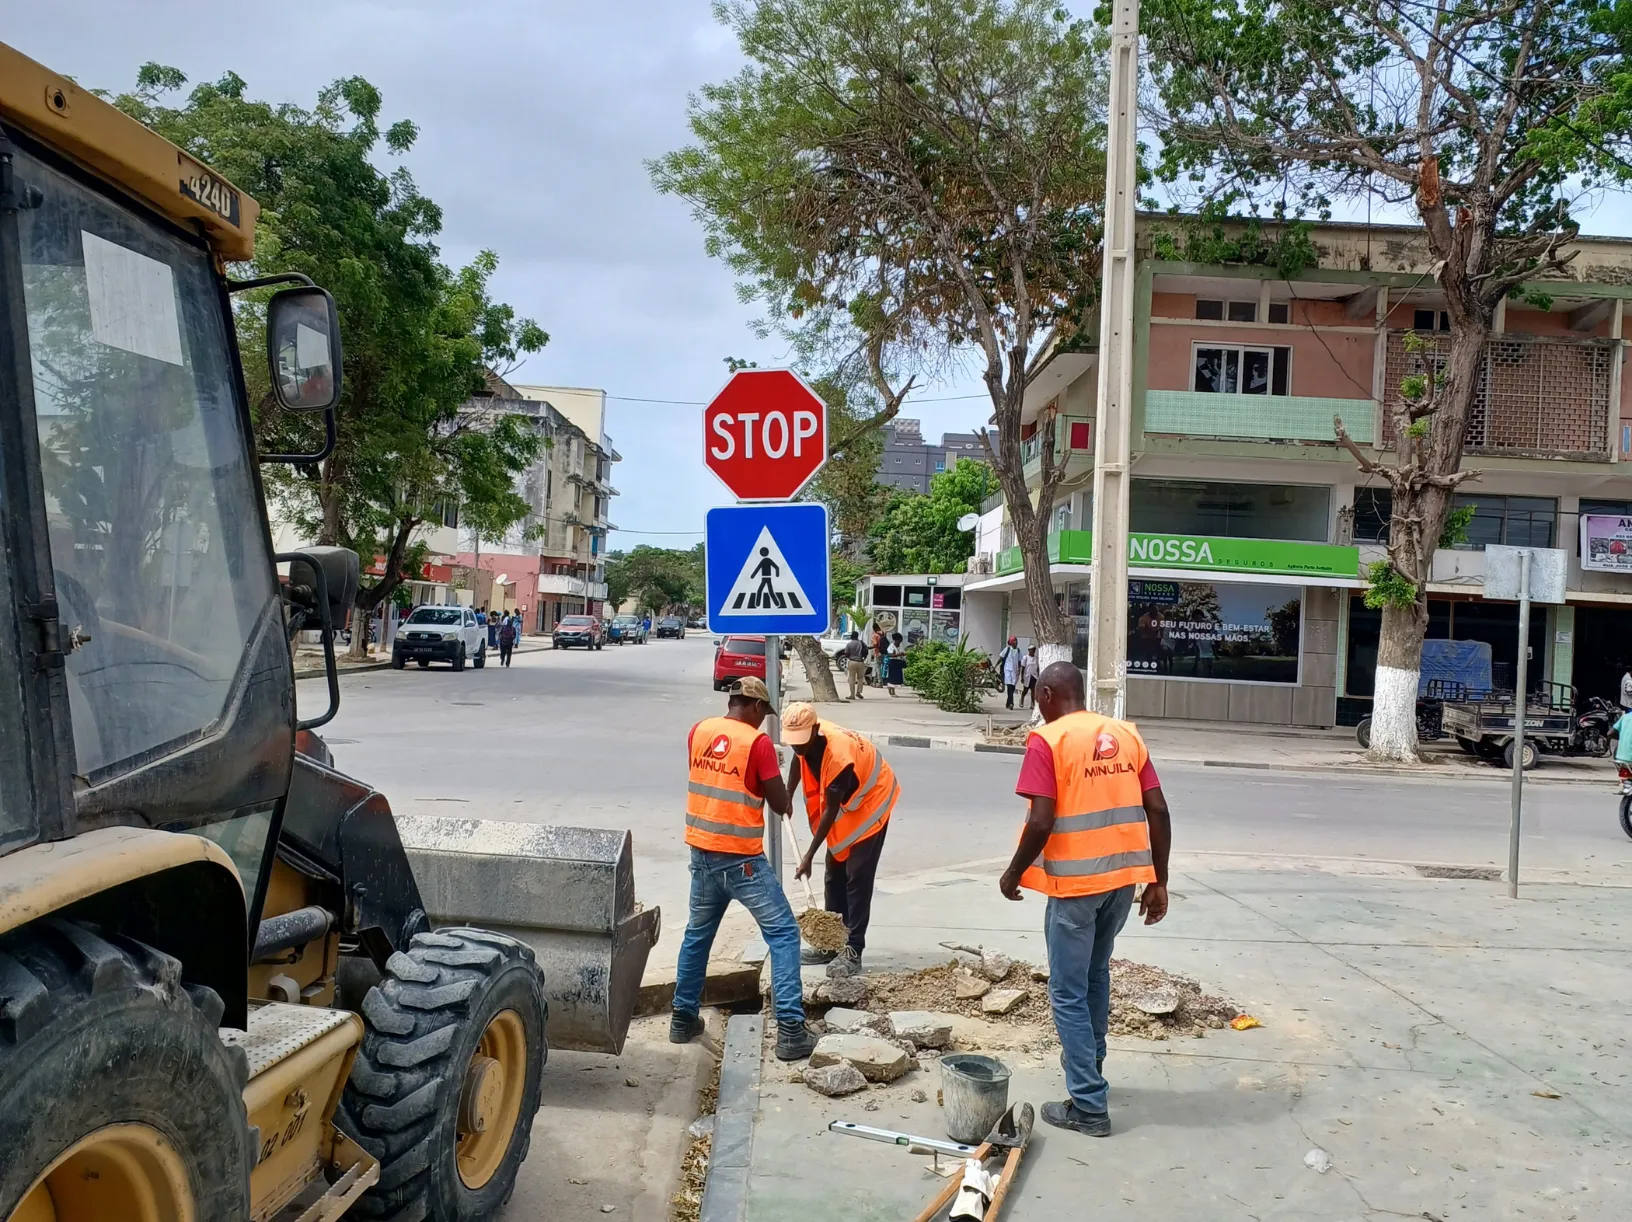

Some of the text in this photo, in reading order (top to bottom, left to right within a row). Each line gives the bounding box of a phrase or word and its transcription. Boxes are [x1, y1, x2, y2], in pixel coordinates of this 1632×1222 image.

[711, 410, 818, 461] STOP
[1129, 537, 1214, 564] NOSSA
[1218, 558, 1274, 567] SEGUROS
[1144, 583, 1174, 592] NOSSA
[1160, 620, 1176, 628] SEU
[1179, 621, 1212, 630] FUTURO
[1214, 623, 1220, 631] E
[1222, 624, 1270, 633] BEM-ESTAR
[1169, 631, 1186, 640] NAS
[1188, 632, 1222, 641] NOSSAS
[693, 757, 740, 777] MINUILA
[1084, 762, 1136, 778] MINUILA
